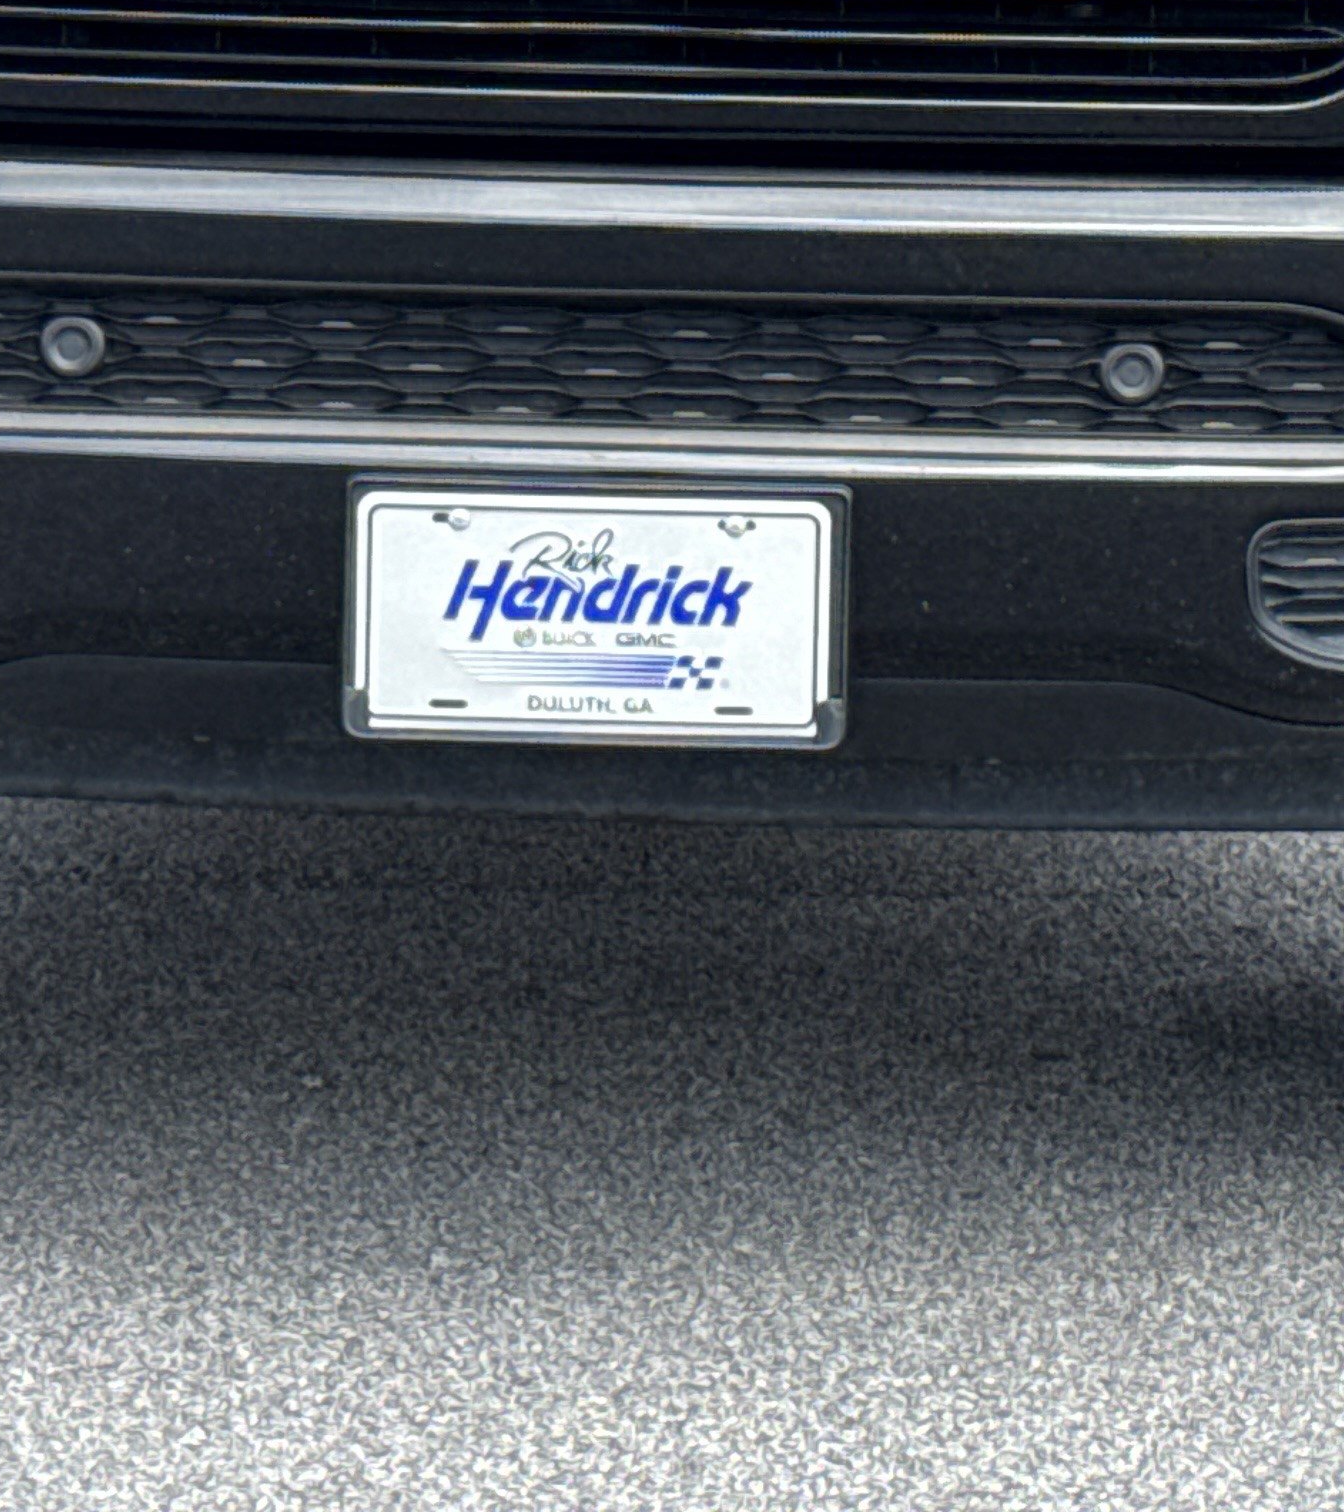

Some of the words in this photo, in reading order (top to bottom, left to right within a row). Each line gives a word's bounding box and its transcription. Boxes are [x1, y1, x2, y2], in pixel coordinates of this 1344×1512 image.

[507, 528, 615, 592] Rick
[443, 559, 754, 642] Hendrick
[542, 630, 596, 648] BUICK
[616, 632, 678, 649] GMC
[623, 696, 655, 714] GA
